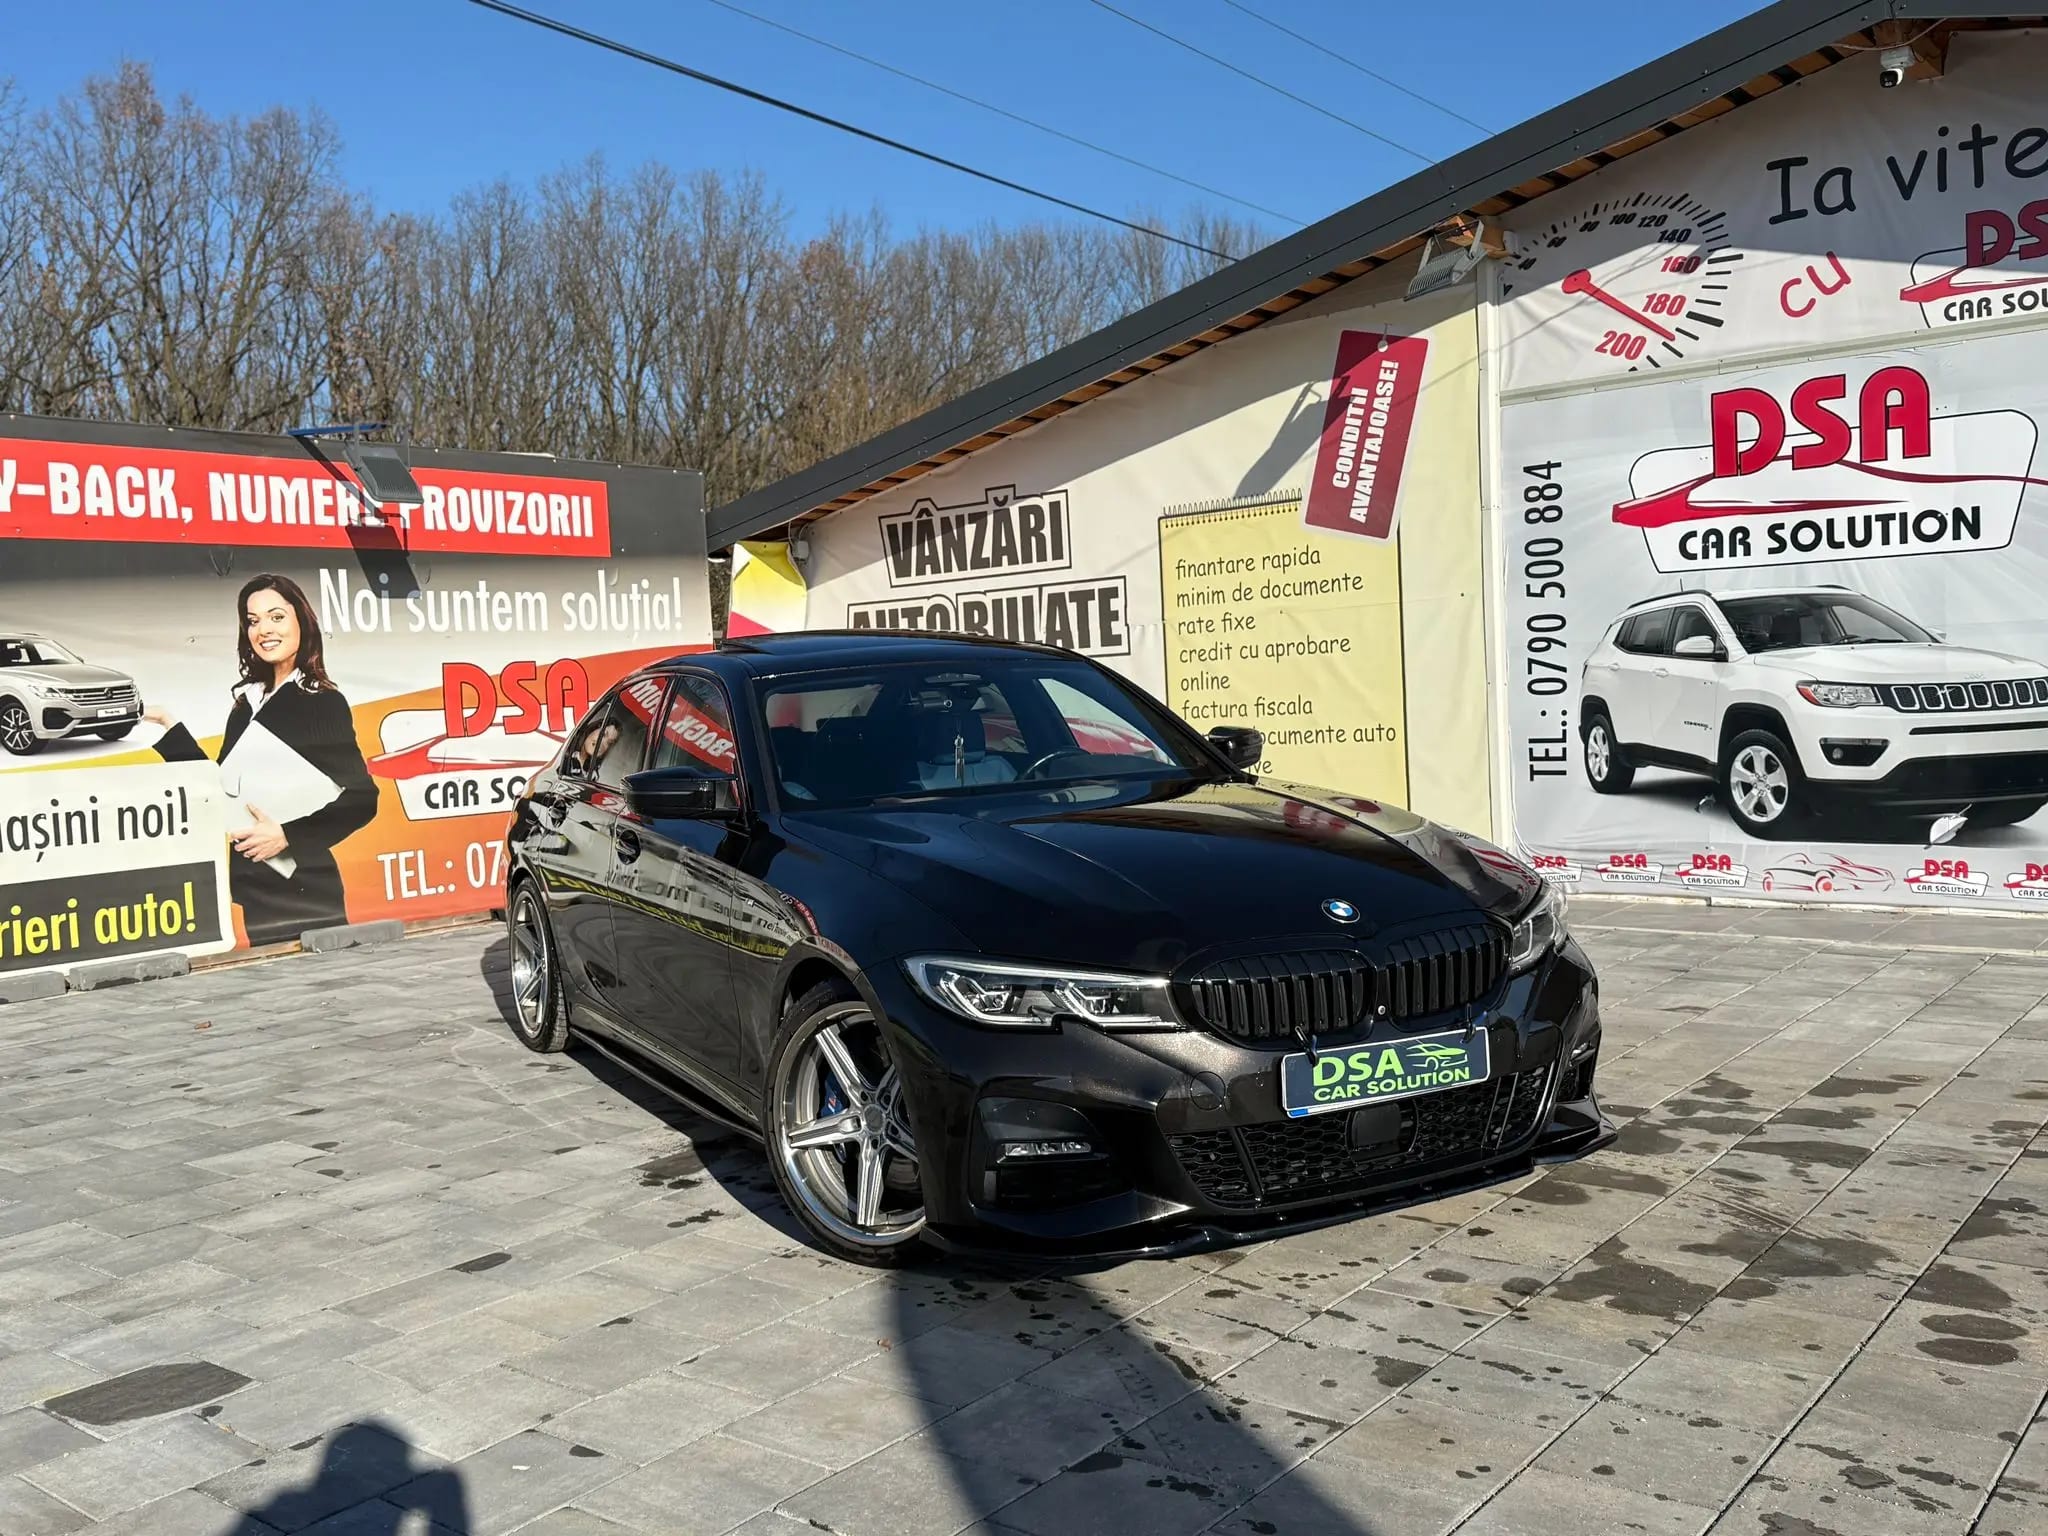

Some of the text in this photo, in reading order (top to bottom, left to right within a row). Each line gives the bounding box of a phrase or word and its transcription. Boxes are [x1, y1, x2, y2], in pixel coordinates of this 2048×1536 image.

[1766, 123, 2048, 225] Ia vite
[1609, 213, 1637, 225] 100
[1637, 214, 1668, 228] 120
[1657, 228, 1692, 243] 140
[1660, 256, 1701, 274] 160
[1780, 250, 1851, 318] cu
[1642, 293, 1687, 316] 180
[1944, 297, 1992, 321] CAR
[1595, 330, 1647, 361] 200
[1710, 365, 1931, 478] DSA
[1349, 360, 1399, 524] AVANTAJOASE!
[886, 494, 1064, 579] VÂNZĂRI
[1678, 505, 1981, 561] CAR SOLUTION
[1176, 545, 1321, 580] finantare rapida
[319, 568, 683, 642] Noi suntem soluția!
[1176, 573, 1364, 608] minim de documente
[1178, 612, 1257, 635] rate fixe
[1523, 461, 1568, 781] TEL.: 0790 500 884
[1179, 635, 1351, 664] credit cu aprobare
[1180, 670, 1231, 691] online
[442, 658, 589, 738] DSA
[1182, 694, 1313, 720] factura fiscala
[1353, 723, 1396, 743] auto
[425, 779, 479, 809] CAR
[0, 786, 188, 862] așini noi!
[377, 849, 457, 901] TEL.:
[1609, 853, 1647, 869] DSA
[1692, 853, 1732, 871] DSA
[1924, 859, 1968, 879] DSA
[1621, 874, 1656, 882] SOLUTION
[1703, 878, 1740, 886] SOLUTION
[1917, 884, 1978, 894] CAR SOLUTION
[94, 881, 196, 945] auto!
[1312, 1048, 1404, 1086] DSA
[1313, 1067, 1470, 1101] CAR SOLUTION
